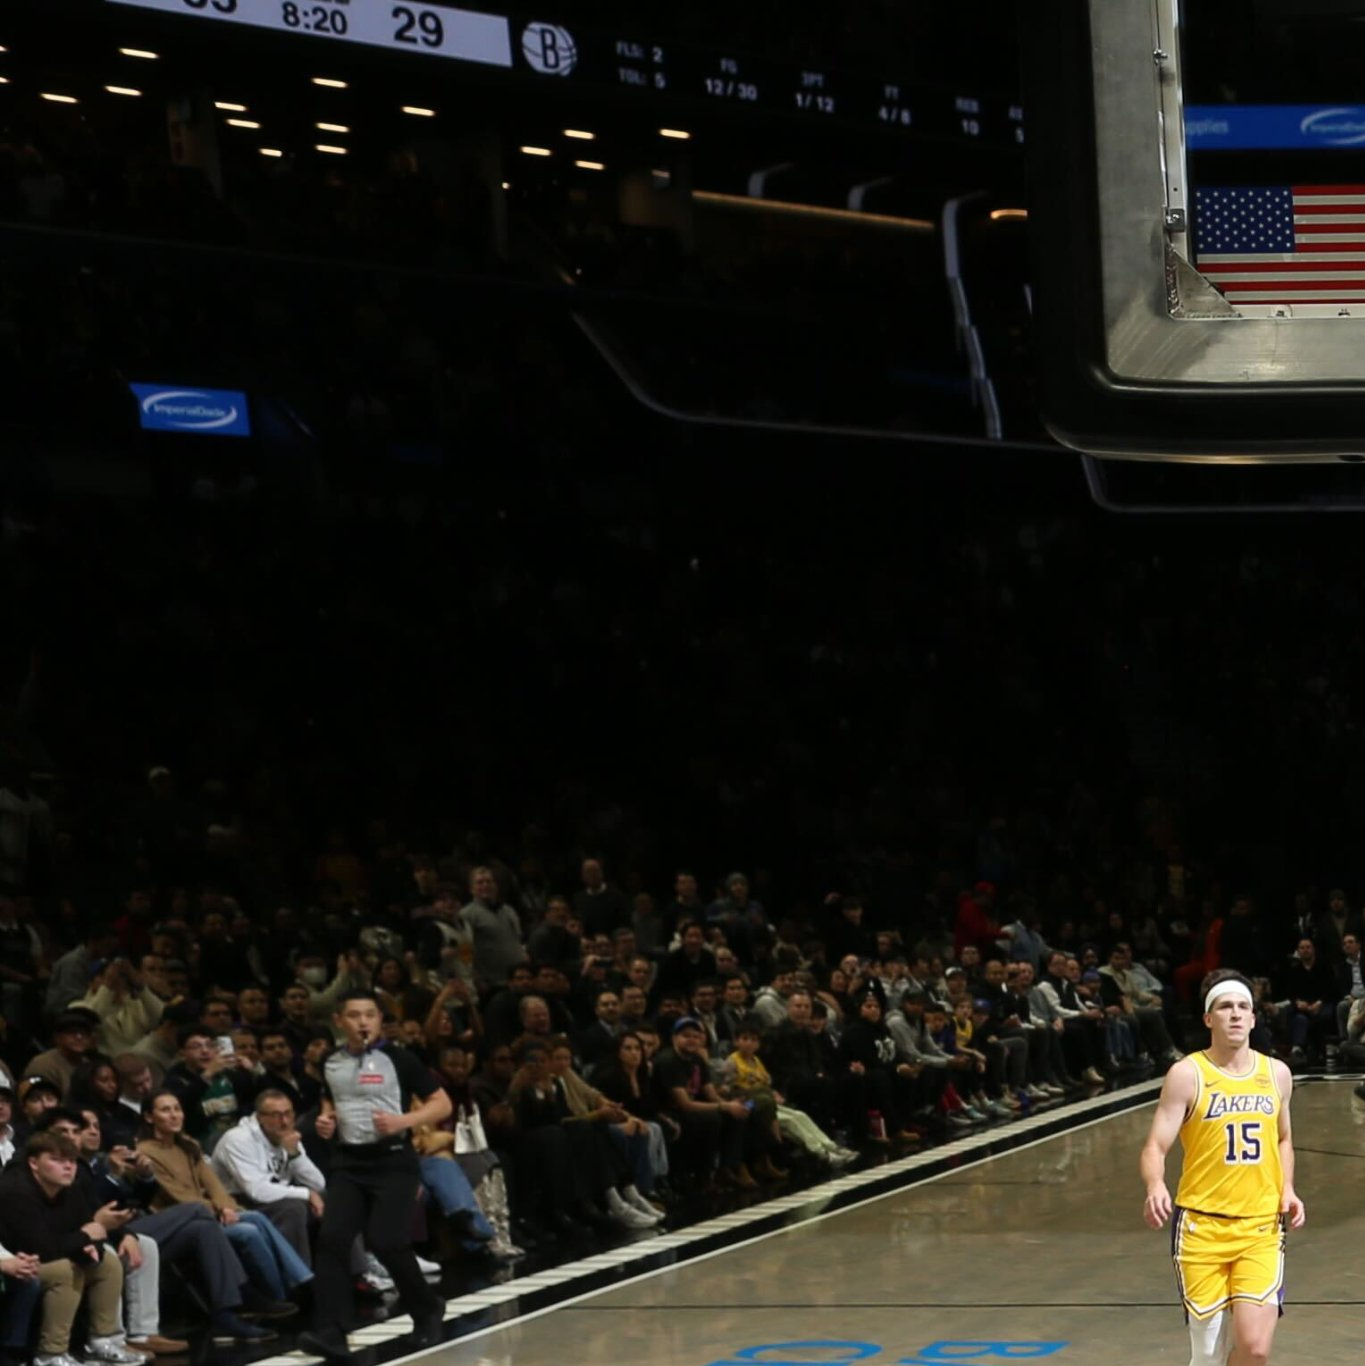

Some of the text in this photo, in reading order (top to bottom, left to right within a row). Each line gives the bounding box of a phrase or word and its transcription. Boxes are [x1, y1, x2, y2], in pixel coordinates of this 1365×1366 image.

[283, 7, 347, 34] 8:20
[392, 9, 444, 47] 29
[652, 46, 664, 63] 2
[1203, 1091, 1276, 1121] LAKERS
[1225, 1122, 1263, 1164] 15
